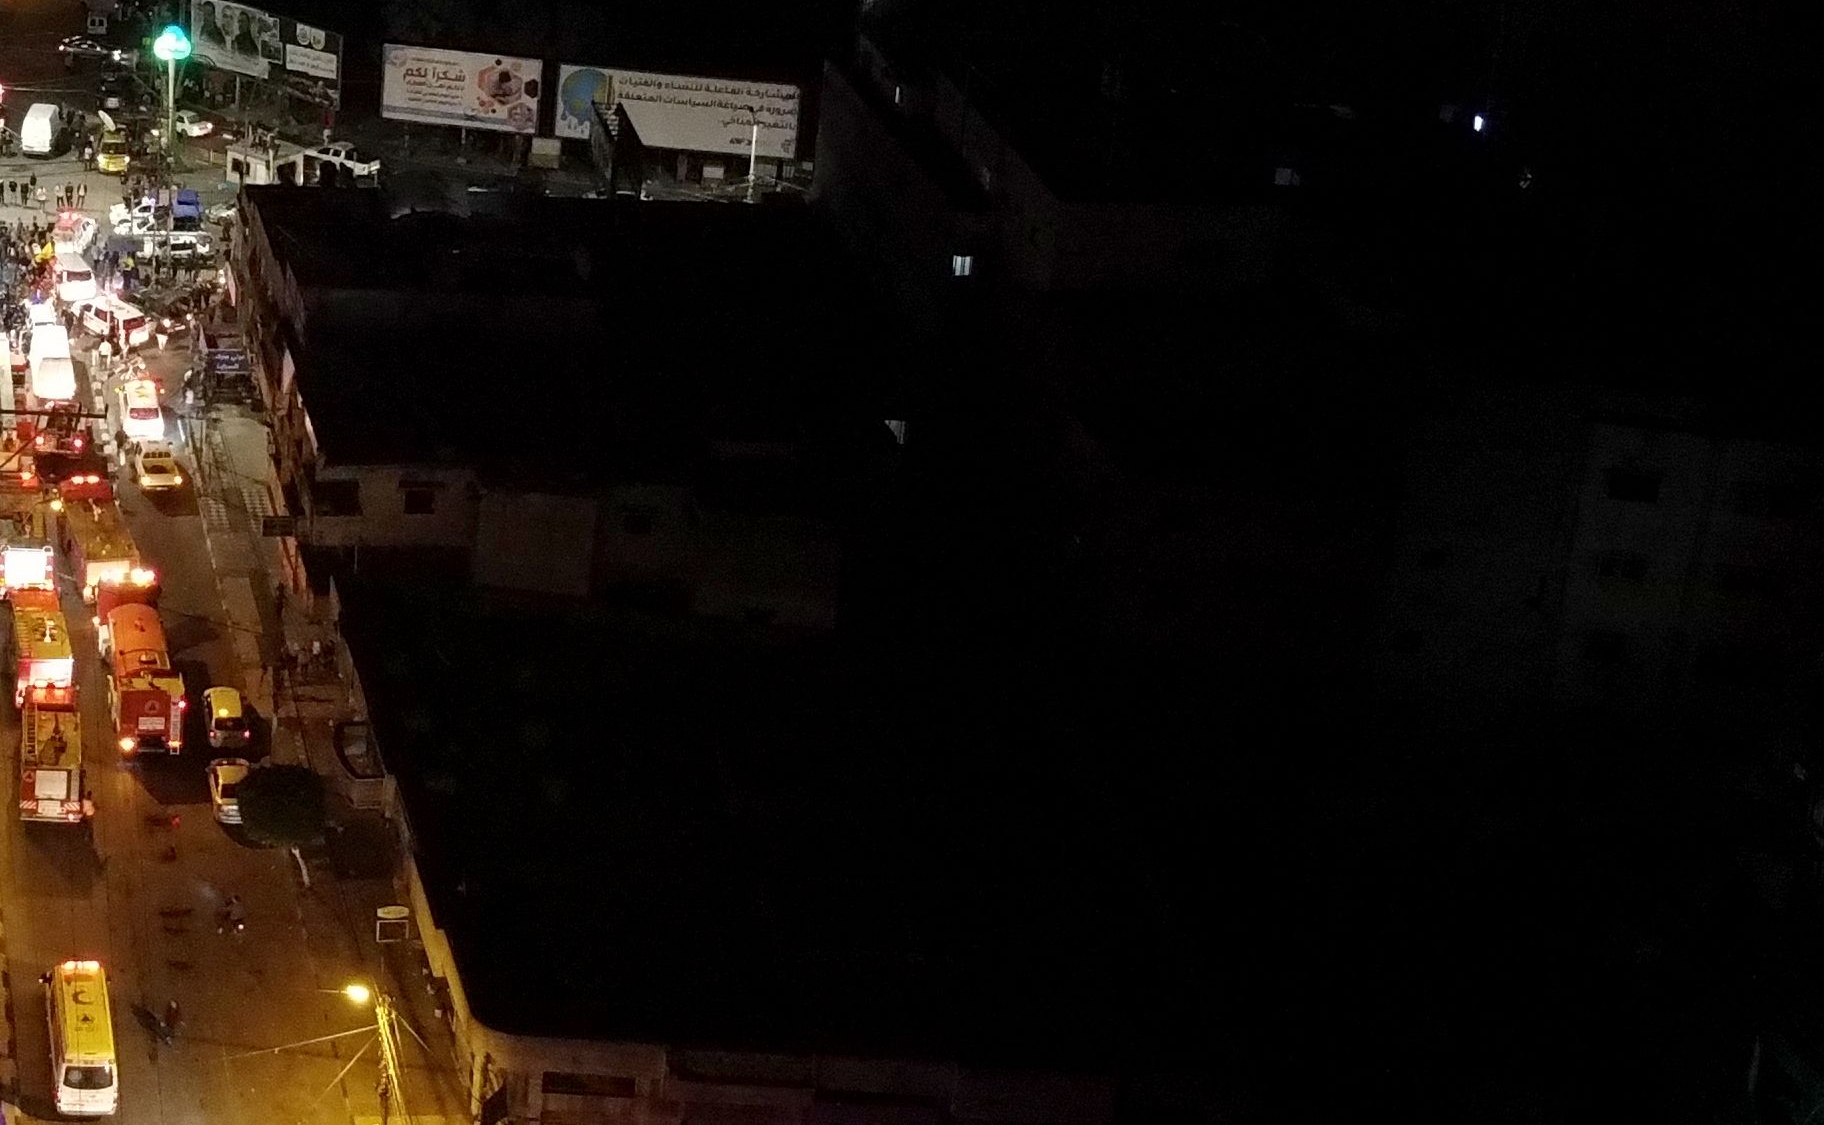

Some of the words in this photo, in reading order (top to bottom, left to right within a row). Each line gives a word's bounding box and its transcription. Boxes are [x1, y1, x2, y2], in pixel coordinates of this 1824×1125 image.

[403, 67, 427, 81] لكم
[664, 80, 703, 92] للنساء
[663, 96, 716, 108] السياسات
